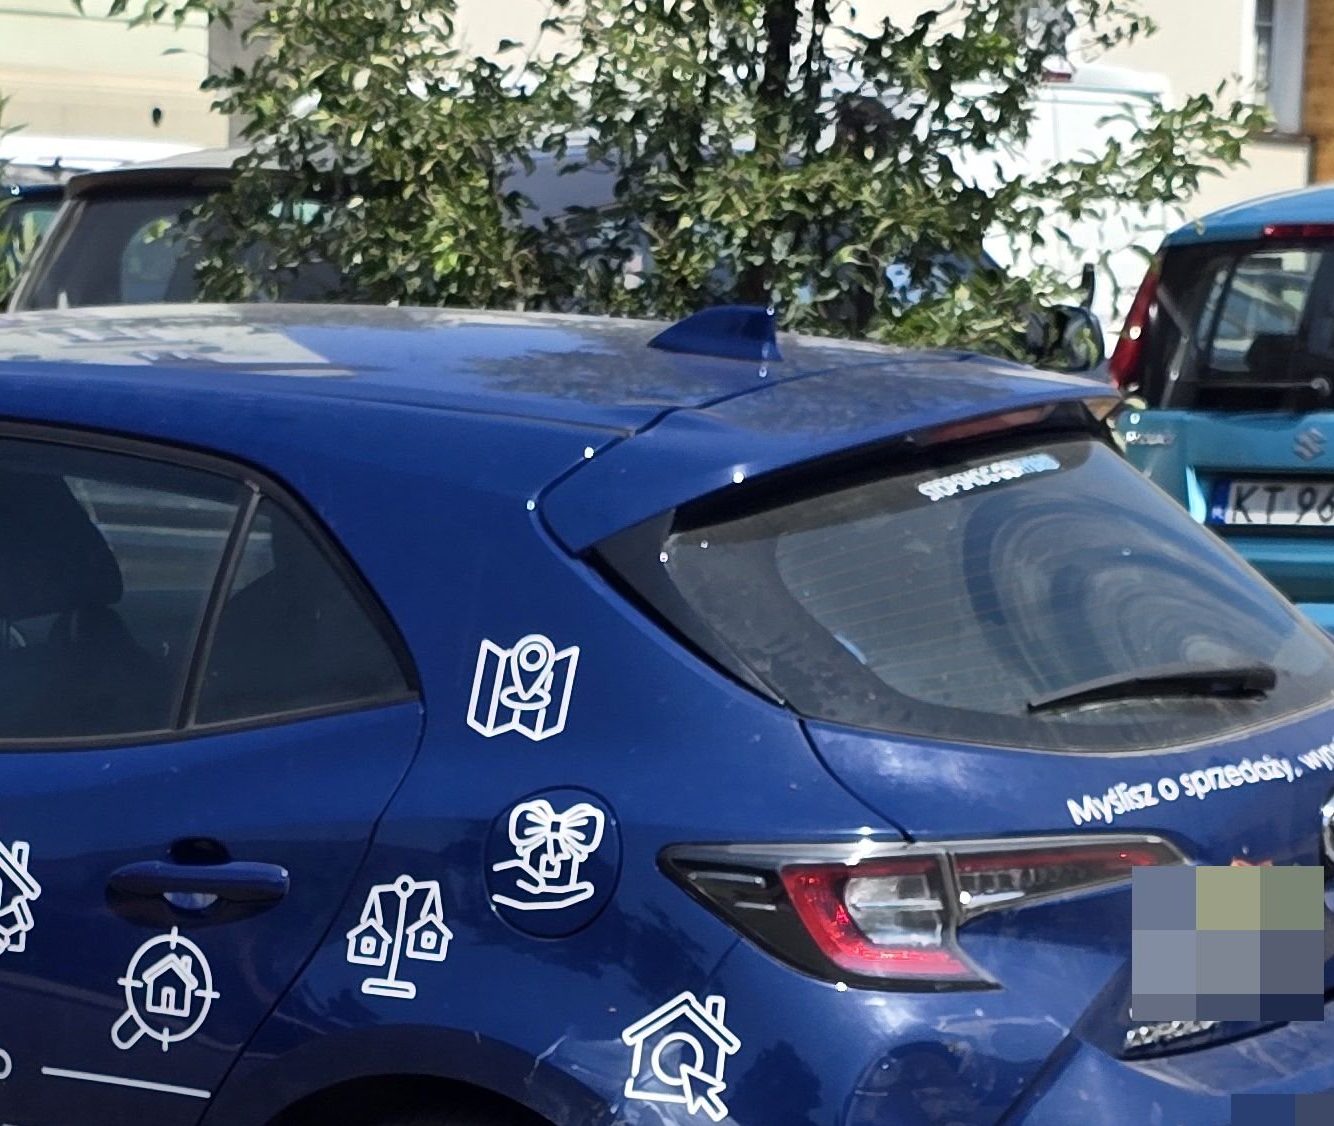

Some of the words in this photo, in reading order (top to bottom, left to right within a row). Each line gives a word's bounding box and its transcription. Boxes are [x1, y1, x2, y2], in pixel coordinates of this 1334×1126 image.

[1232, 485, 1285, 523] KT
[1067, 782, 1159, 825] Myślisz
[1158, 777, 1180, 801] o
